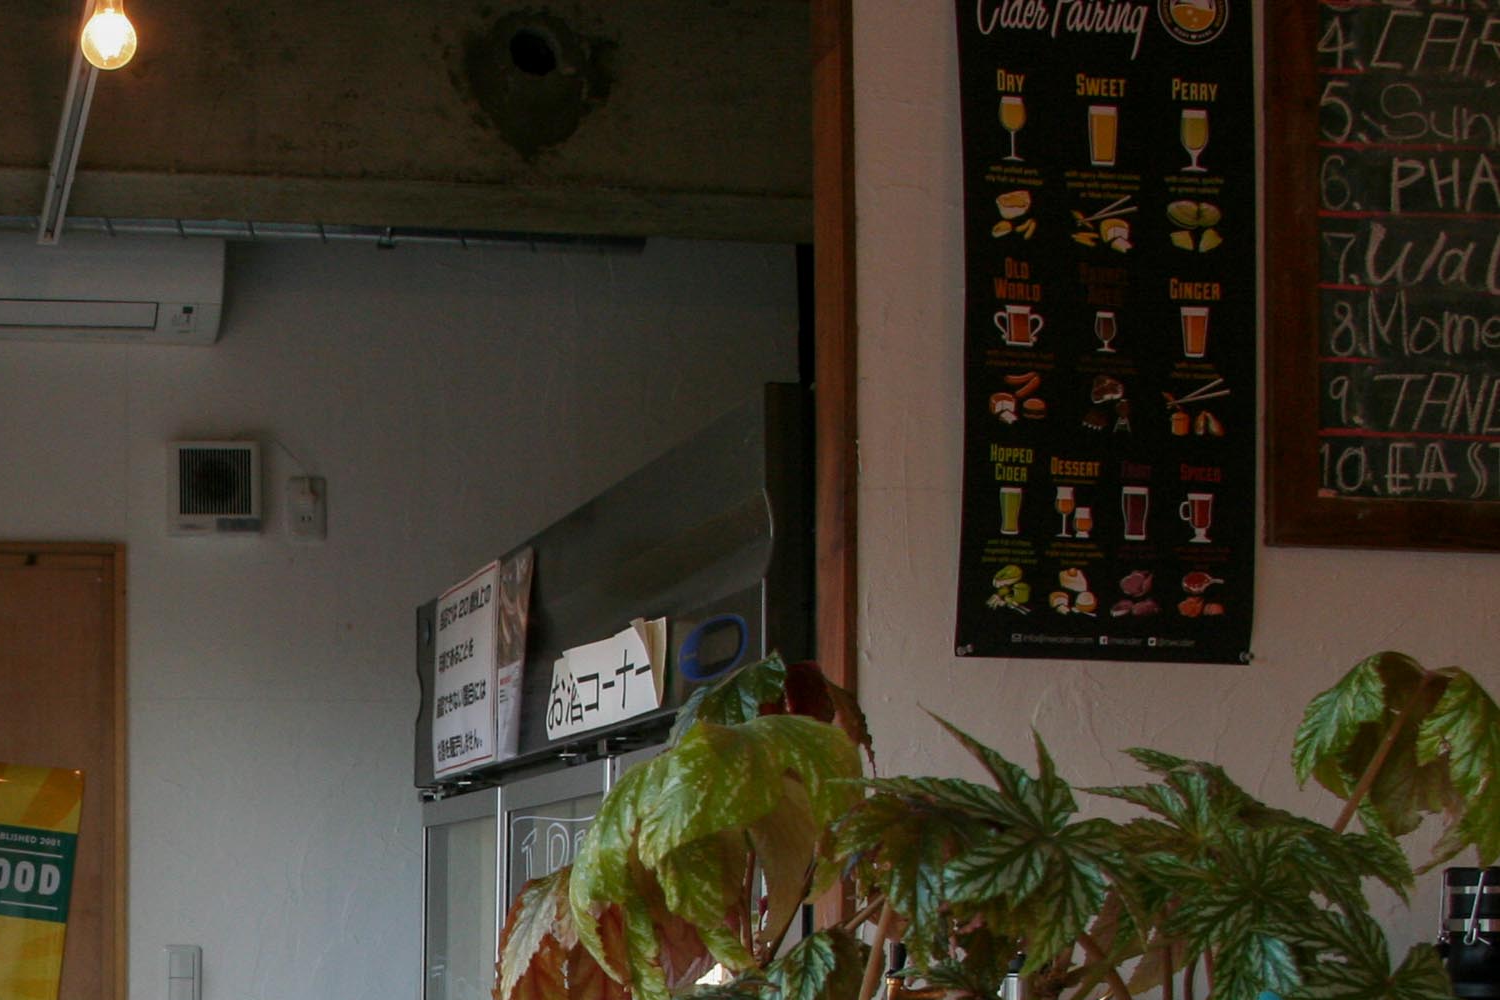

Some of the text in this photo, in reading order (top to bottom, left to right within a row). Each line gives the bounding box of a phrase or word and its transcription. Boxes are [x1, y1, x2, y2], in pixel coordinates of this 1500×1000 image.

[976, 0, 1050, 35] Cider
[996, 69, 1025, 93] DRY
[1075, 73, 1127, 98] SWEET
[1171, 78, 1218, 102] PERRY
[1376, 82, 1500, 143] Sun
[993, 276, 1042, 302] WORLD
[1169, 277, 1221, 301] GINGER
[990, 443, 1034, 465] HOPPED
[994, 463, 1028, 483] CIDER
[1050, 456, 1101, 478] DESSERT
